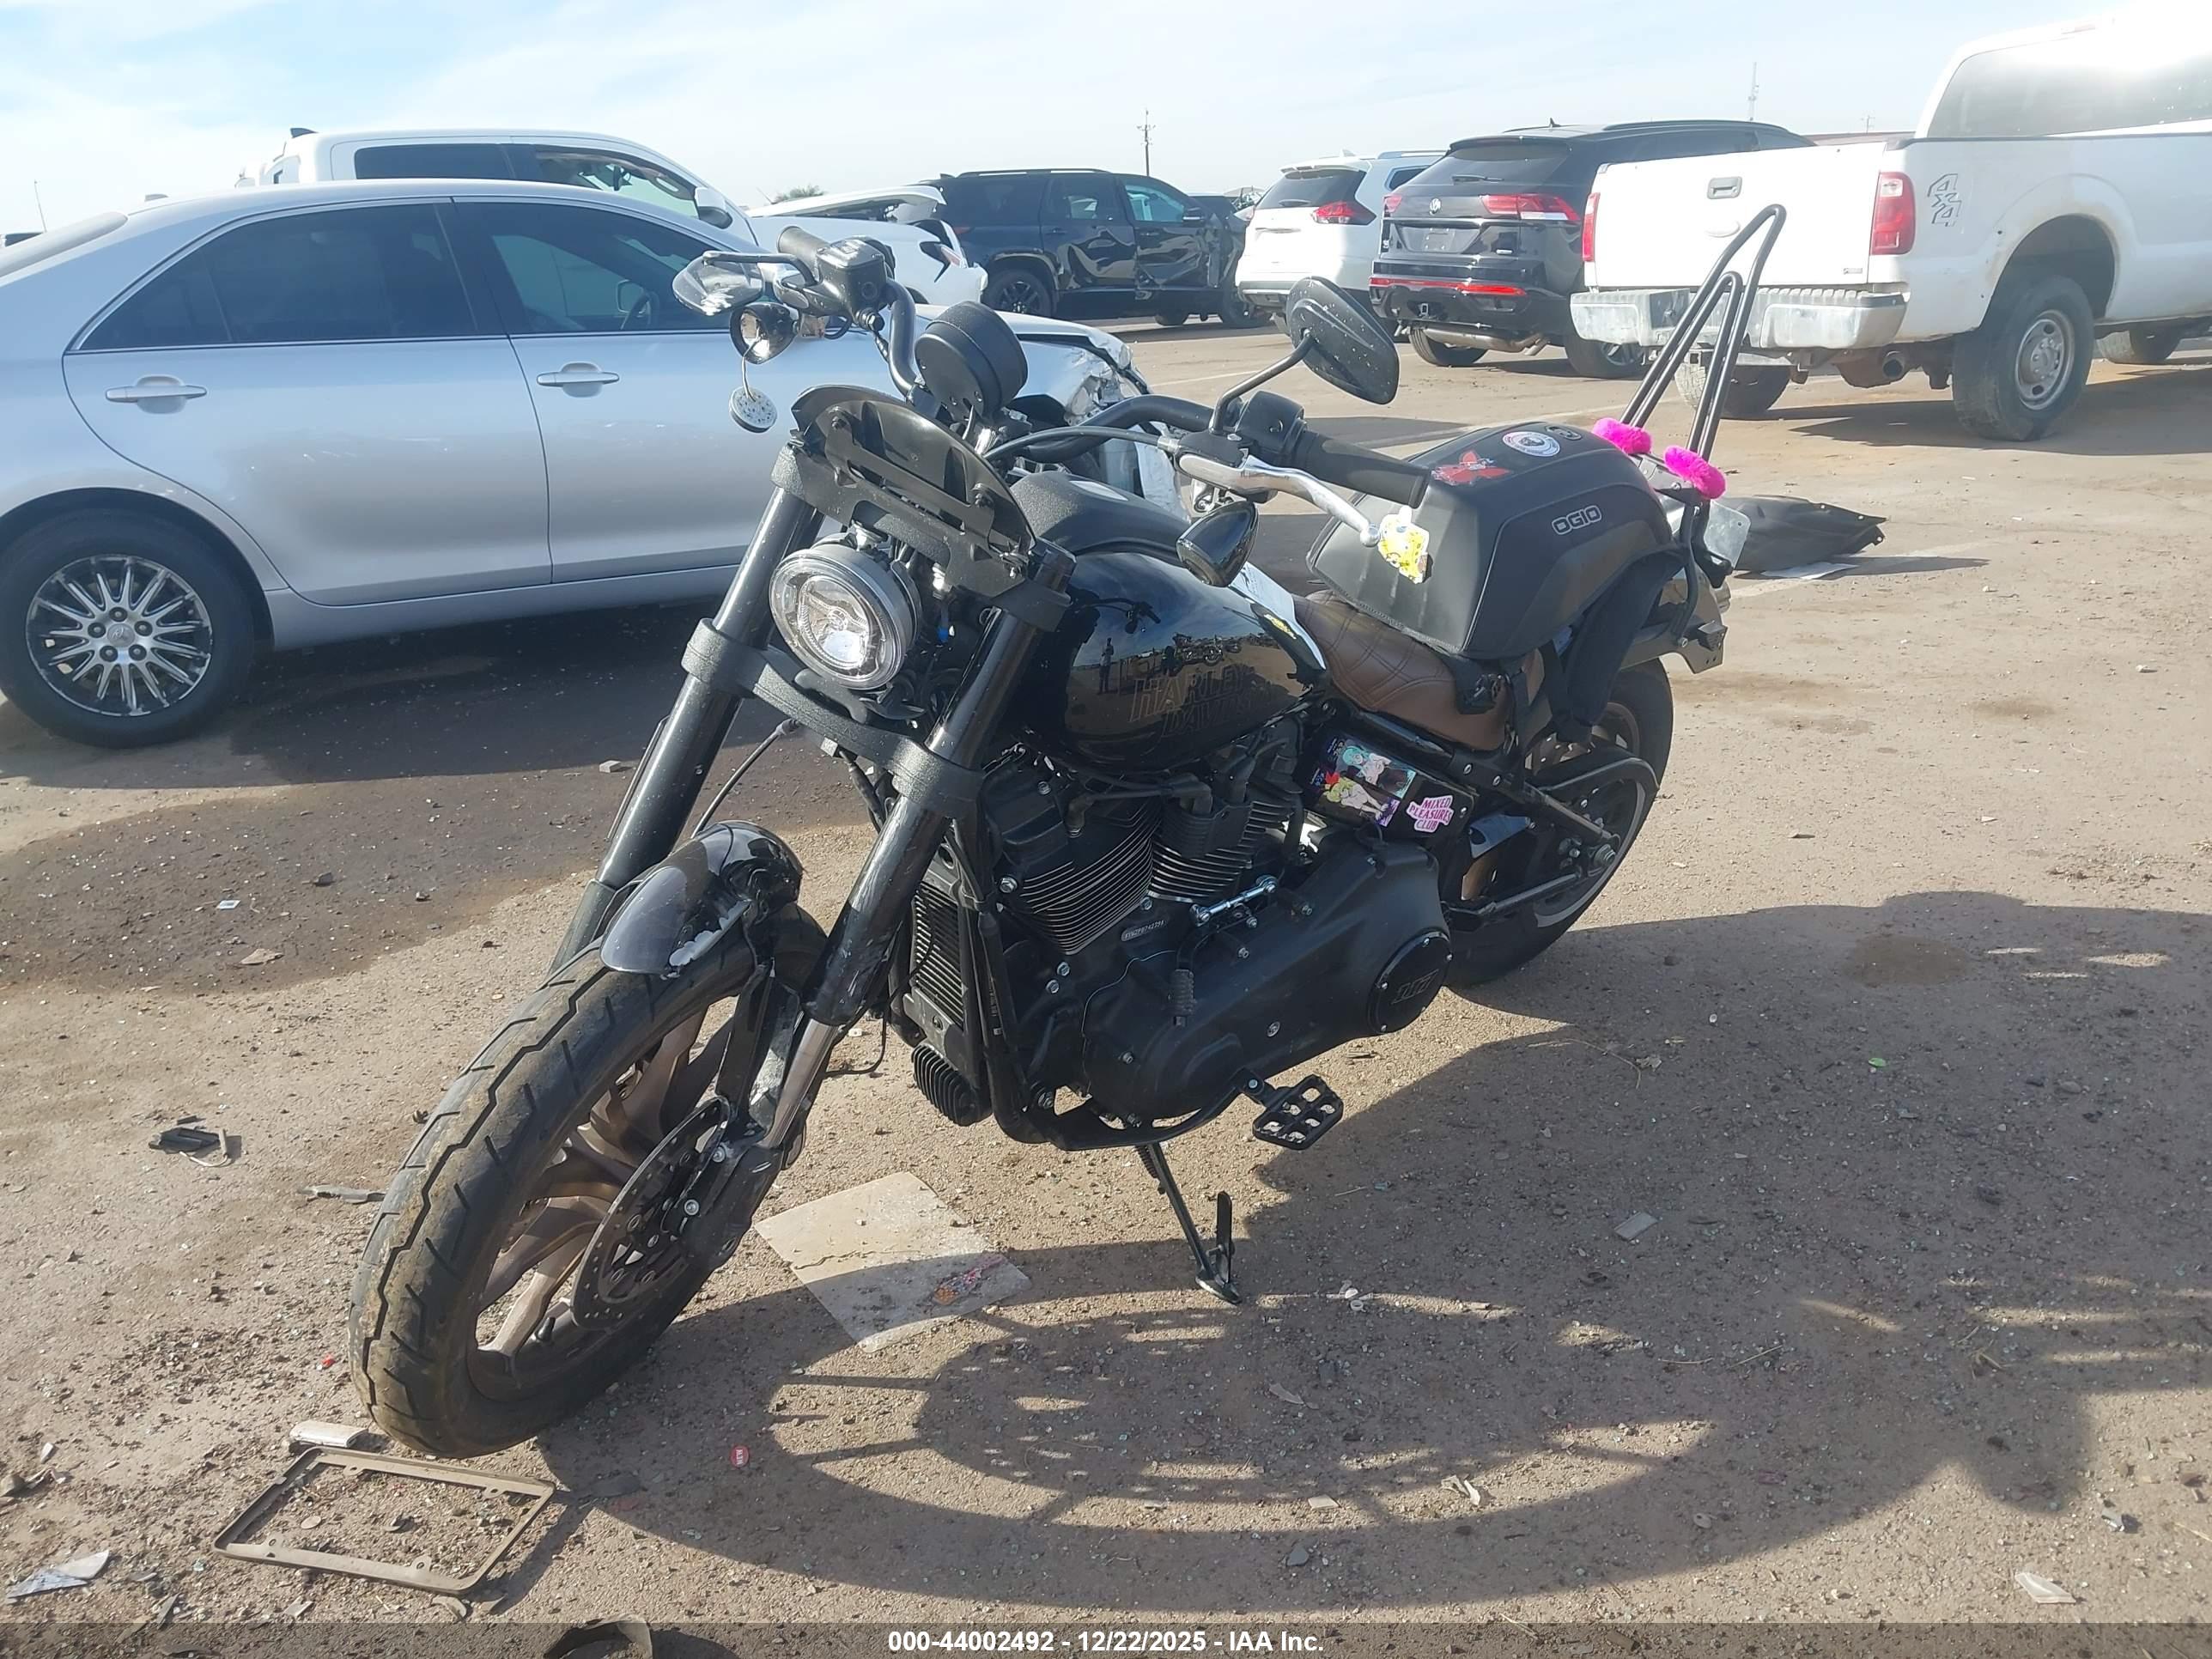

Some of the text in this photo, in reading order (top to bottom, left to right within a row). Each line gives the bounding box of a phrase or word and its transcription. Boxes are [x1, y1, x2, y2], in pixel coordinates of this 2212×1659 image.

[1551, 505, 1602, 535] OGIO
[1128, 663, 1245, 722] HARLEY
[1422, 797, 1451, 809] MIXED
[1408, 804, 1452, 823] PLEASURES
[1416, 818, 1438, 830] CLUB
